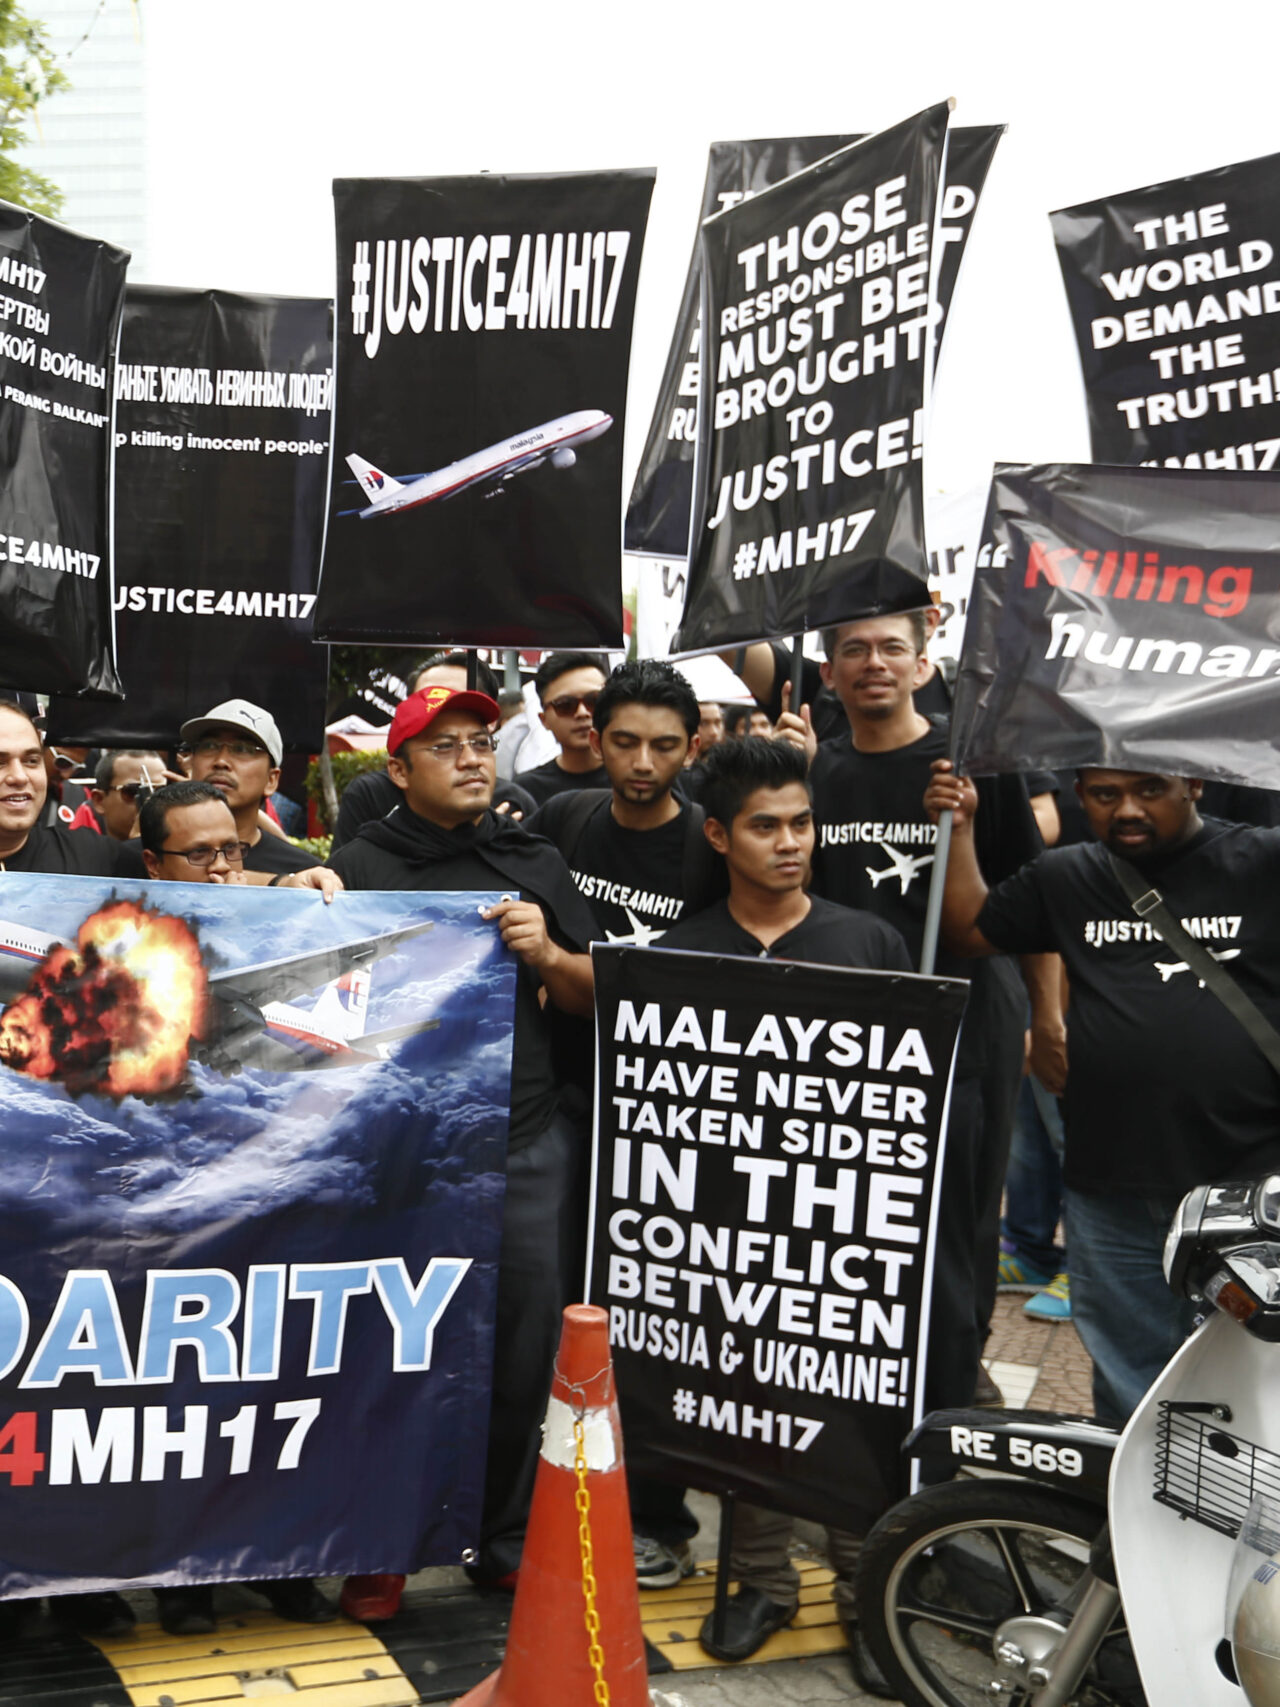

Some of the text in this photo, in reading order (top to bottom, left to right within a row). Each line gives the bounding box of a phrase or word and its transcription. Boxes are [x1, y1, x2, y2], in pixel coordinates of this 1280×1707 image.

[737, 174, 907, 292] THOSE
[1133, 202, 1230, 250] THE
[351, 230, 631, 359] #JUSTICE4MH17
[720, 222, 929, 335] RESPONSIBLE
[1100, 239, 1274, 301] WORLD
[718, 293, 844, 383] MUST
[861, 261, 929, 327] BE
[1149, 333, 1245, 380] THE
[4, 385, 51, 414] PERANG
[40, 347, 106, 390] ВОЙНЫ
[714, 314, 929, 430] BROUGHT
[131, 431, 183, 450] killing
[187, 433, 261, 452] innocent
[786, 401, 834, 442] TO
[708, 409, 924, 530] JUSTICE!
[733, 508, 876, 581] #MH17
[1024, 541, 1253, 618] Killing
[820, 821, 939, 848] JUSTICE4MH17
[570, 870, 684, 920] USTICE4MH17
[614, 1000, 933, 1076] MALAYSIA
[615, 1054, 928, 1125] HAVE NEVER
[612, 1096, 928, 1170] TAKEN SIDES
[612, 1137, 923, 1244] IN THE
[608, 1208, 914, 1297] CONFLICT
[607, 1254, 906, 1350] BETWEEN
[609, 1304, 910, 1408] RUSSIA & UKRAINE!
[673, 1388, 825, 1452] #MH17
[950, 1425, 1083, 1477] RE 569
